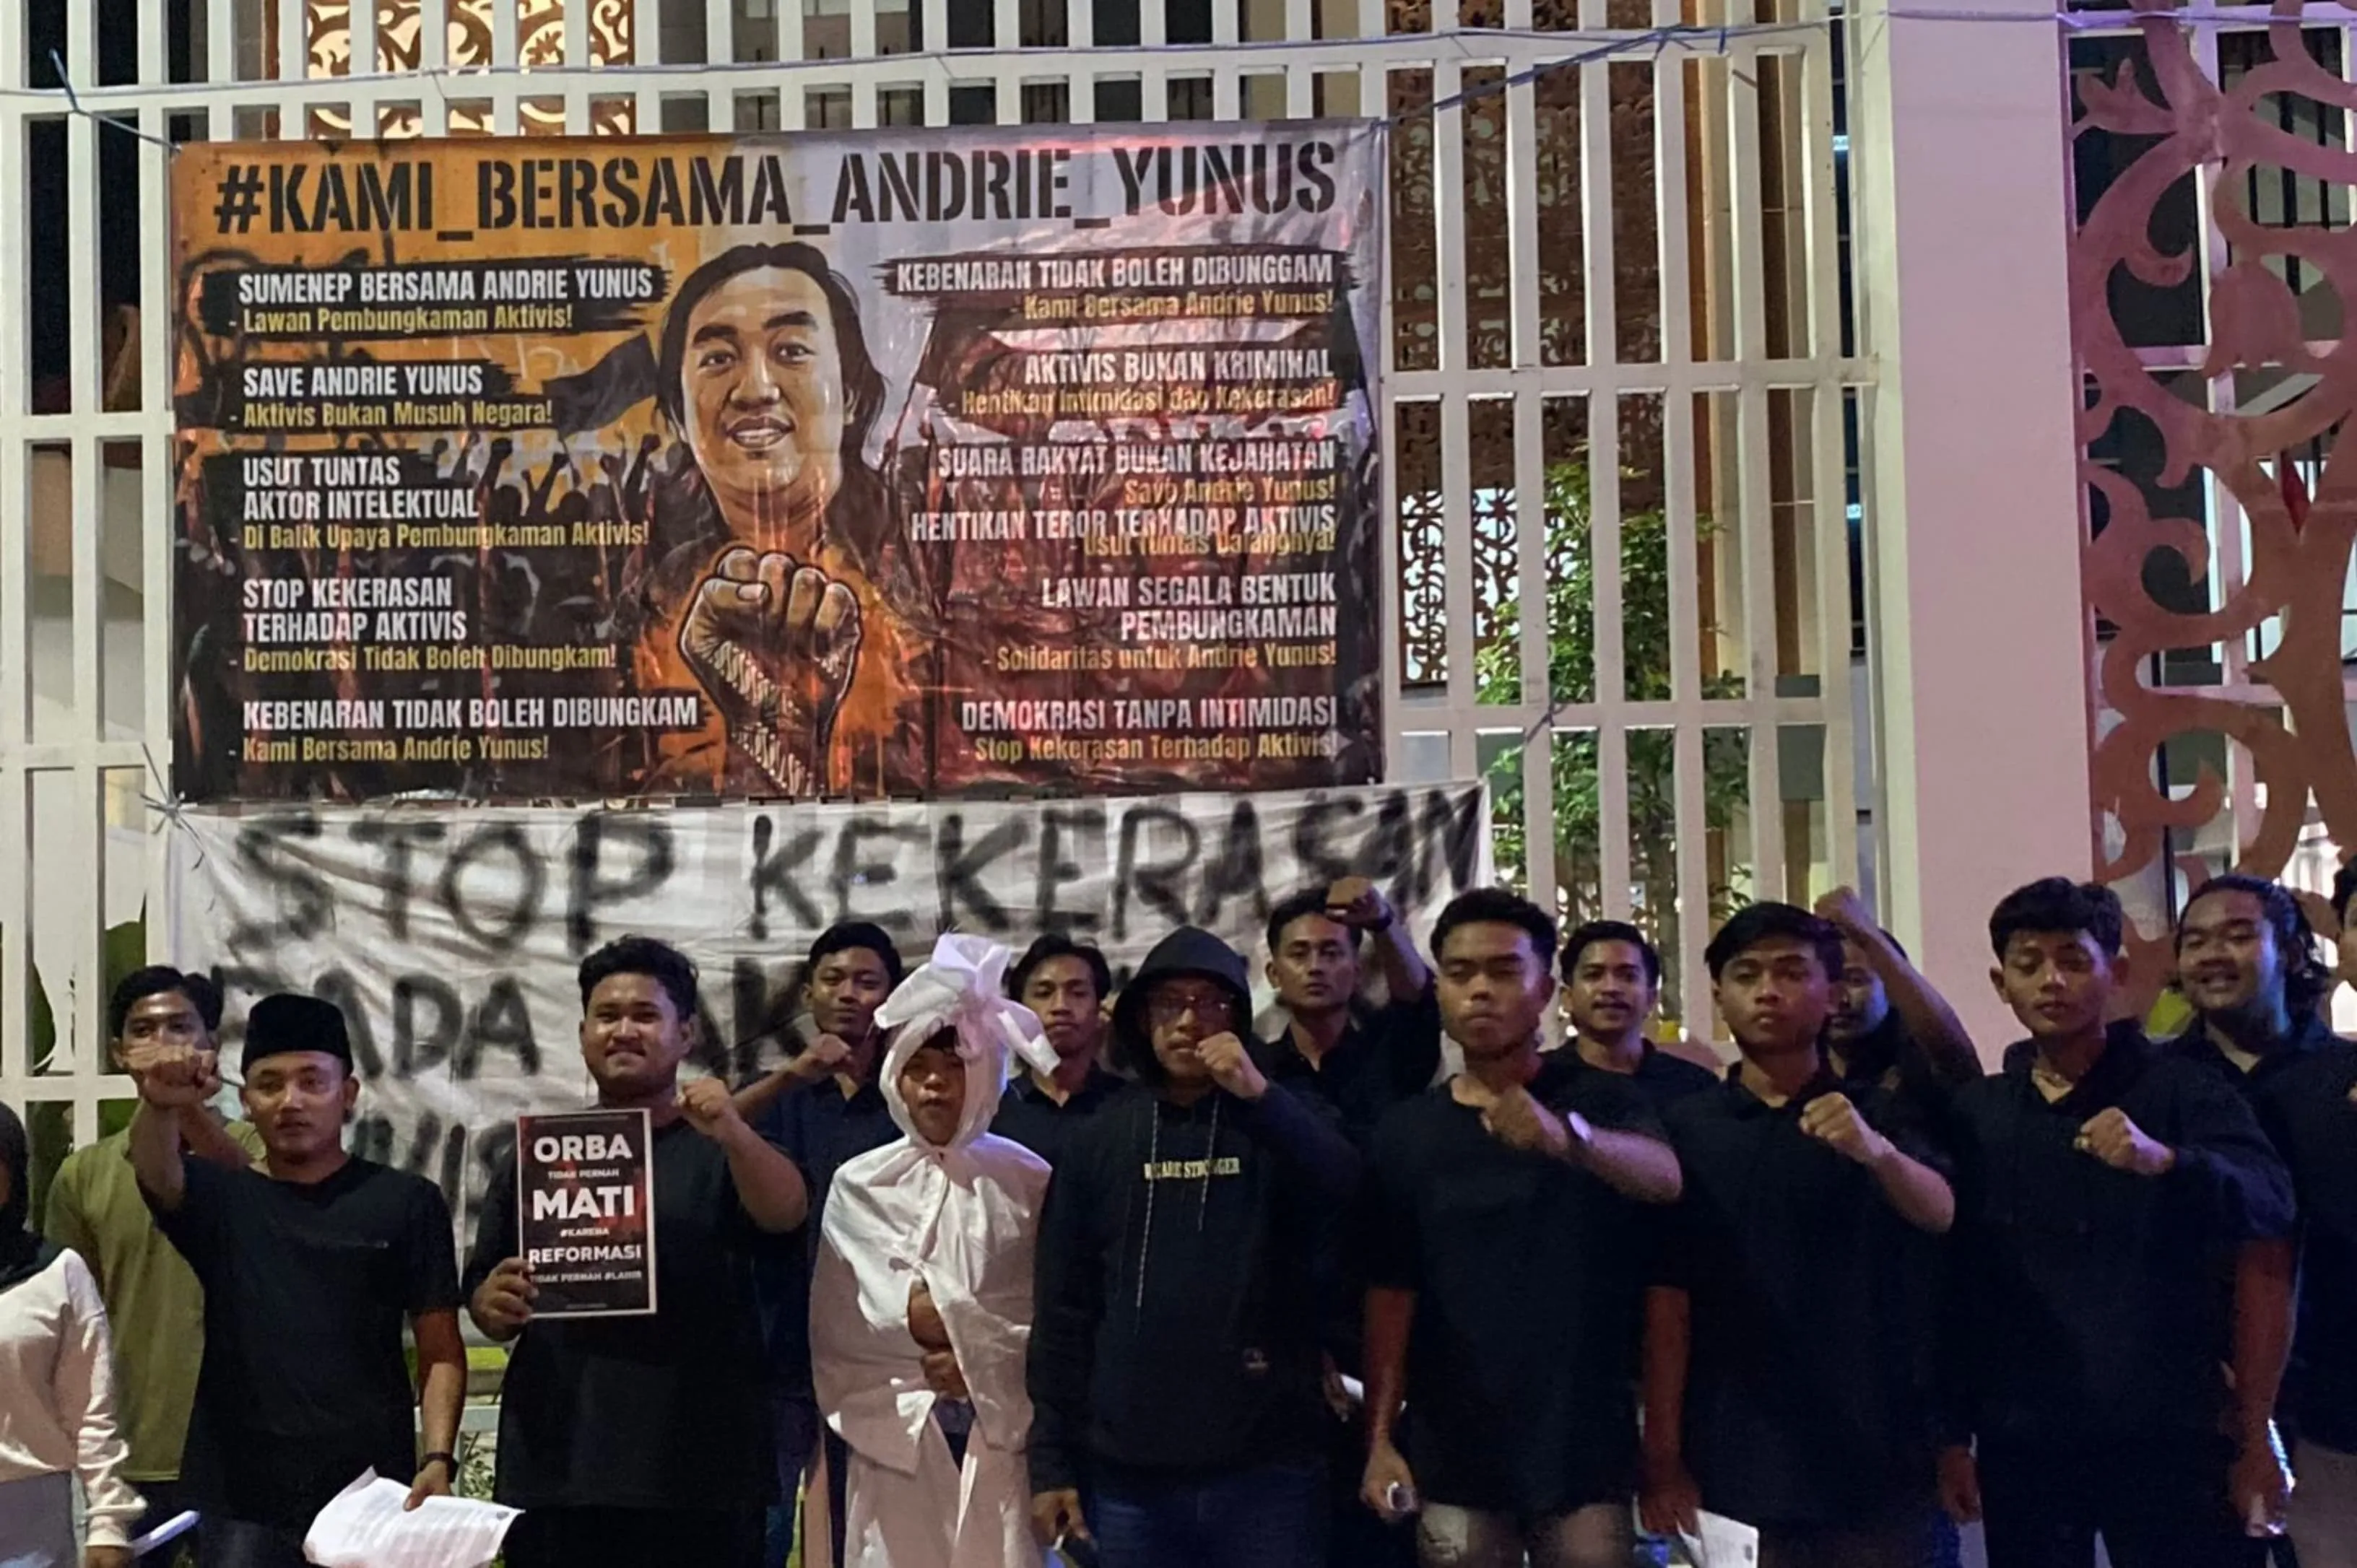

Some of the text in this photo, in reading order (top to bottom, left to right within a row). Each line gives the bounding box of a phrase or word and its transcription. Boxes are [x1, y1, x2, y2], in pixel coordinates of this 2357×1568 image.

[214, 141, 1335, 241] #KAMI_BERSAMA_ANDRIE_YUNUS
[238, 267, 653, 304] SUMENEP BERSAMA ANDRIE YUNUS
[898, 261, 1031, 292] KEBENARAN
[1038, 261, 1106, 288] TIDAK
[1113, 259, 1184, 287] BOLEH
[243, 309, 311, 333] Lawan
[317, 307, 488, 334] Pembungkaman
[494, 303, 573, 330] Aktivis!
[1186, 292, 1254, 315] Andrie
[1261, 290, 1334, 313] Yunus!
[243, 365, 483, 398] SAVE ANDRIE YUNUS
[1025, 349, 1334, 384] AKTIVIS BUKAN KRIMINAL
[243, 401, 316, 428] Aktivis
[322, 401, 387, 427] Bukan
[394, 400, 466, 426] Musuh
[472, 399, 552, 427] Negara!
[243, 456, 401, 487] USUT TUNTAS
[938, 440, 1335, 477] SUARA RAKYAT BUKAN KEJAHATAN
[1261, 474, 1335, 501] Yunus!
[243, 489, 479, 521] AKTOR INTELEKTUAL
[244, 525, 264, 549] Di
[269, 523, 321, 549] Balik
[326, 525, 392, 551] Upaya
[396, 522, 566, 550] Pembungkaman
[572, 521, 650, 546] Aktivis!
[911, 504, 1335, 541] HENTIKAN TEROR TERHADAP AKTIVIS
[243, 577, 452, 609] STOP KEKERASAN
[1041, 572, 1337, 608] LAWAN SEGALA BENTUK
[243, 611, 468, 643] TERHADAP AKTIVIS
[1120, 606, 1337, 642] PEMBUNGKAMAN
[244, 648, 357, 673] Demokrasi
[364, 646, 419, 671] Tidak
[426, 645, 485, 670] Boleh
[492, 644, 616, 671] Dibungkam!
[997, 645, 1113, 671] Solidaritas
[1119, 645, 1181, 669] untuk
[1187, 643, 1258, 668] Andrie
[1264, 641, 1337, 666] Yunus!
[243, 696, 698, 731] KEBENARAN TIDAK BOLEH DIBUNGKAM
[962, 694, 1337, 731] DEMOKRASI TANPA INTIMIDASI
[243, 737, 298, 762] Kami
[302, 736, 397, 762] Bersama
[403, 736, 472, 762] Andrie
[477, 735, 549, 760] Yunus!
[975, 738, 1023, 763] Stop
[1030, 735, 1144, 760] Kekerasan
[1150, 734, 1250, 762] Terhadap
[1256, 732, 1337, 757] Aktivis!
[227, 807, 677, 956] STOP
[534, 1133, 633, 1163] ORBA
[533, 1185, 635, 1221] MATI
[529, 1245, 642, 1264] REFORMASI
